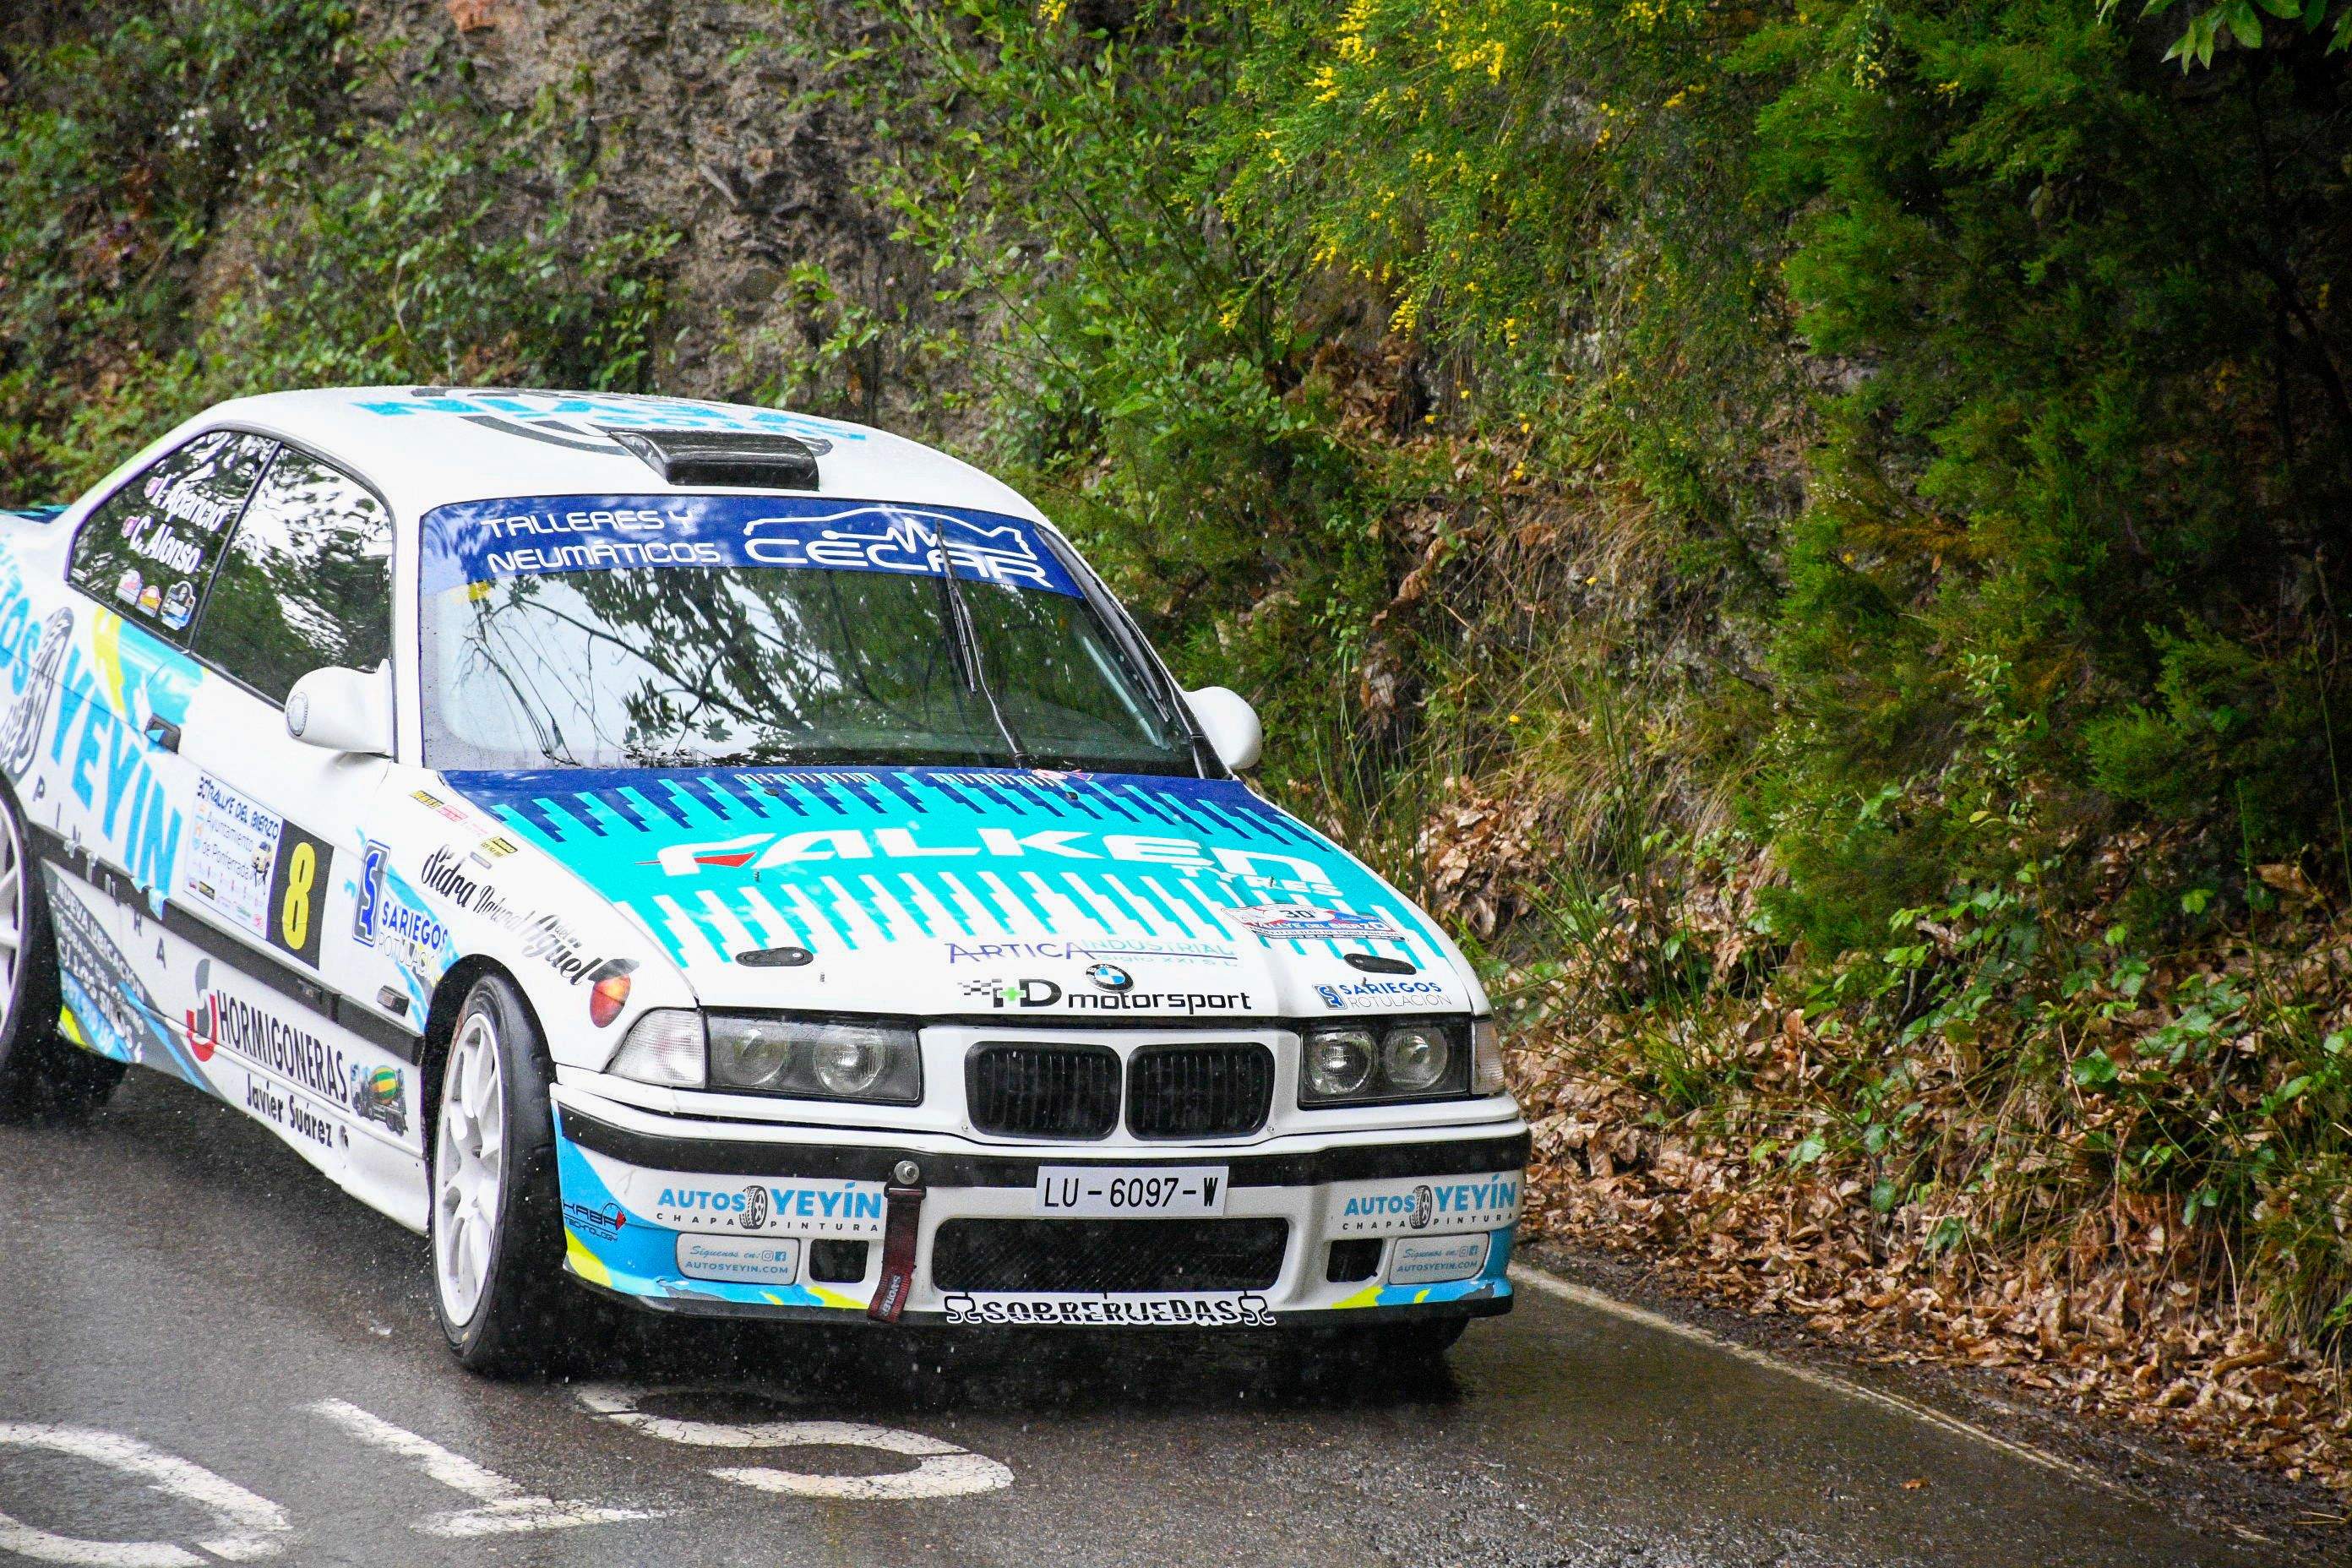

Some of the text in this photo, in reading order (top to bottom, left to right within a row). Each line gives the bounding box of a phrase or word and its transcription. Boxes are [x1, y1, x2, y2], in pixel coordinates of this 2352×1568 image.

[481, 510, 695, 538] TALLERES Y
[142, 523, 203, 574] Alonso
[487, 539, 721, 574] NEUMÁTICOS
[744, 538, 1054, 588] CECAR
[647, 827, 1337, 888] FALKEN
[421, 844, 478, 908] Sidra
[1172, 863, 1345, 897] TYRES
[281, 841, 316, 950] 8
[383, 901, 449, 950] SARIEGOS
[1081, 939, 1234, 956] INDUSTRIAL
[1068, 992, 1252, 1015] motorsport
[1339, 982, 1442, 995] SARIEGOS
[216, 989, 348, 1103] HORMIGONERAS
[247, 1073, 334, 1149] Javier Suárez
[657, 1182, 882, 1219] AUTOS YEYÍN
[1343, 1173, 1516, 1217] AUTOS YEYÍN
[656, 1212, 879, 1232] CHAPA PINTURA
[1342, 1213, 1513, 1230] CHAPA PINTURA
[685, 1260, 789, 1274] AUTOSYEYIN.COM
[983, 1300, 1242, 1325] SOBRERUEDAS
